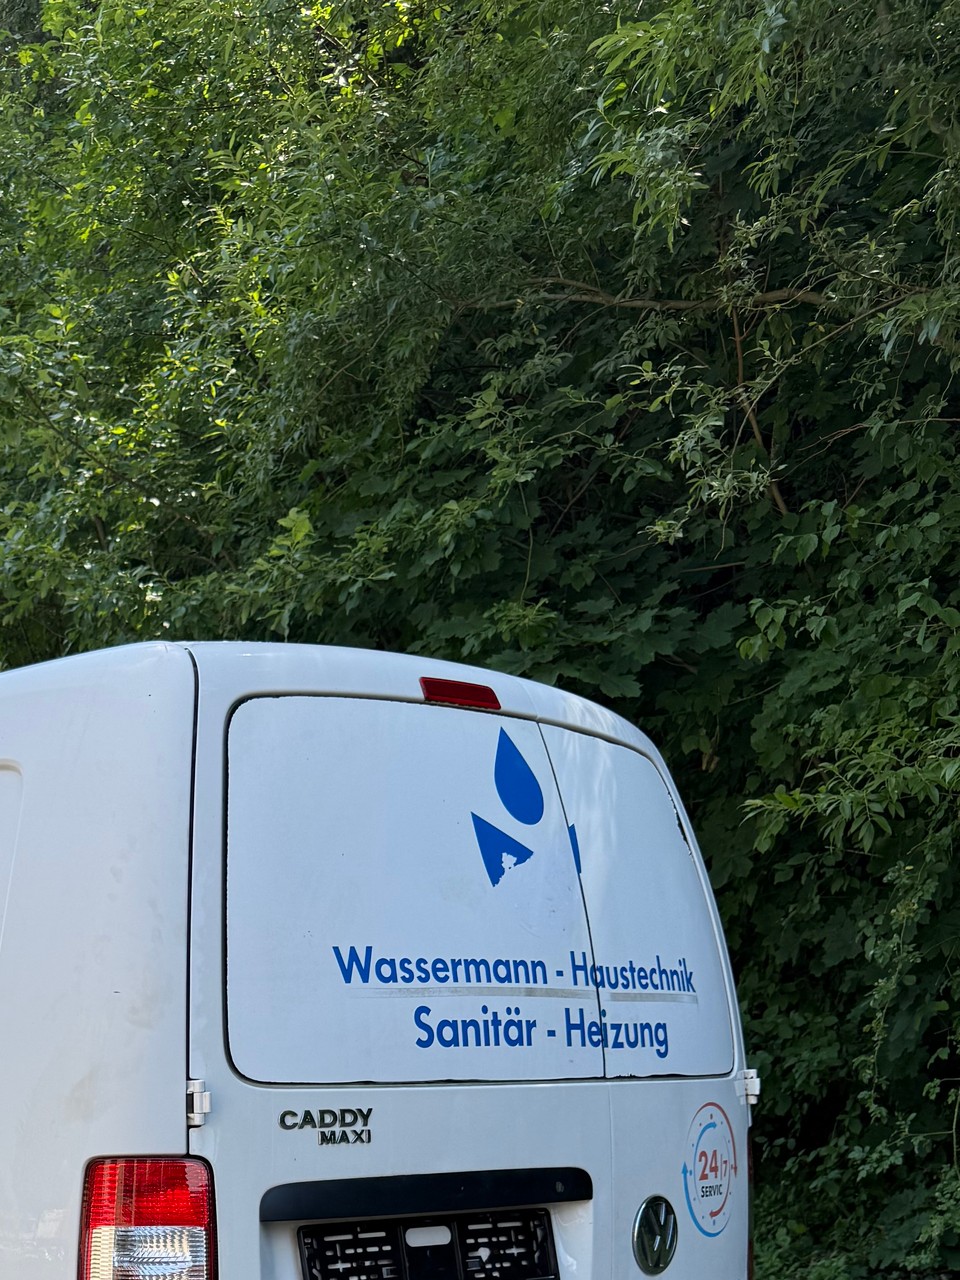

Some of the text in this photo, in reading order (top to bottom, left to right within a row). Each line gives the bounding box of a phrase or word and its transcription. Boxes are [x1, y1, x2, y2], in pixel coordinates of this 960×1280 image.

[332, 945, 548, 984] Wassermann
[570, 950, 696, 993] Haustechnik
[414, 1005, 537, 1048] Sanitär
[564, 1007, 669, 1059] Heizung
[278, 1107, 373, 1130] CADDY
[318, 1129, 371, 1145] MAXI
